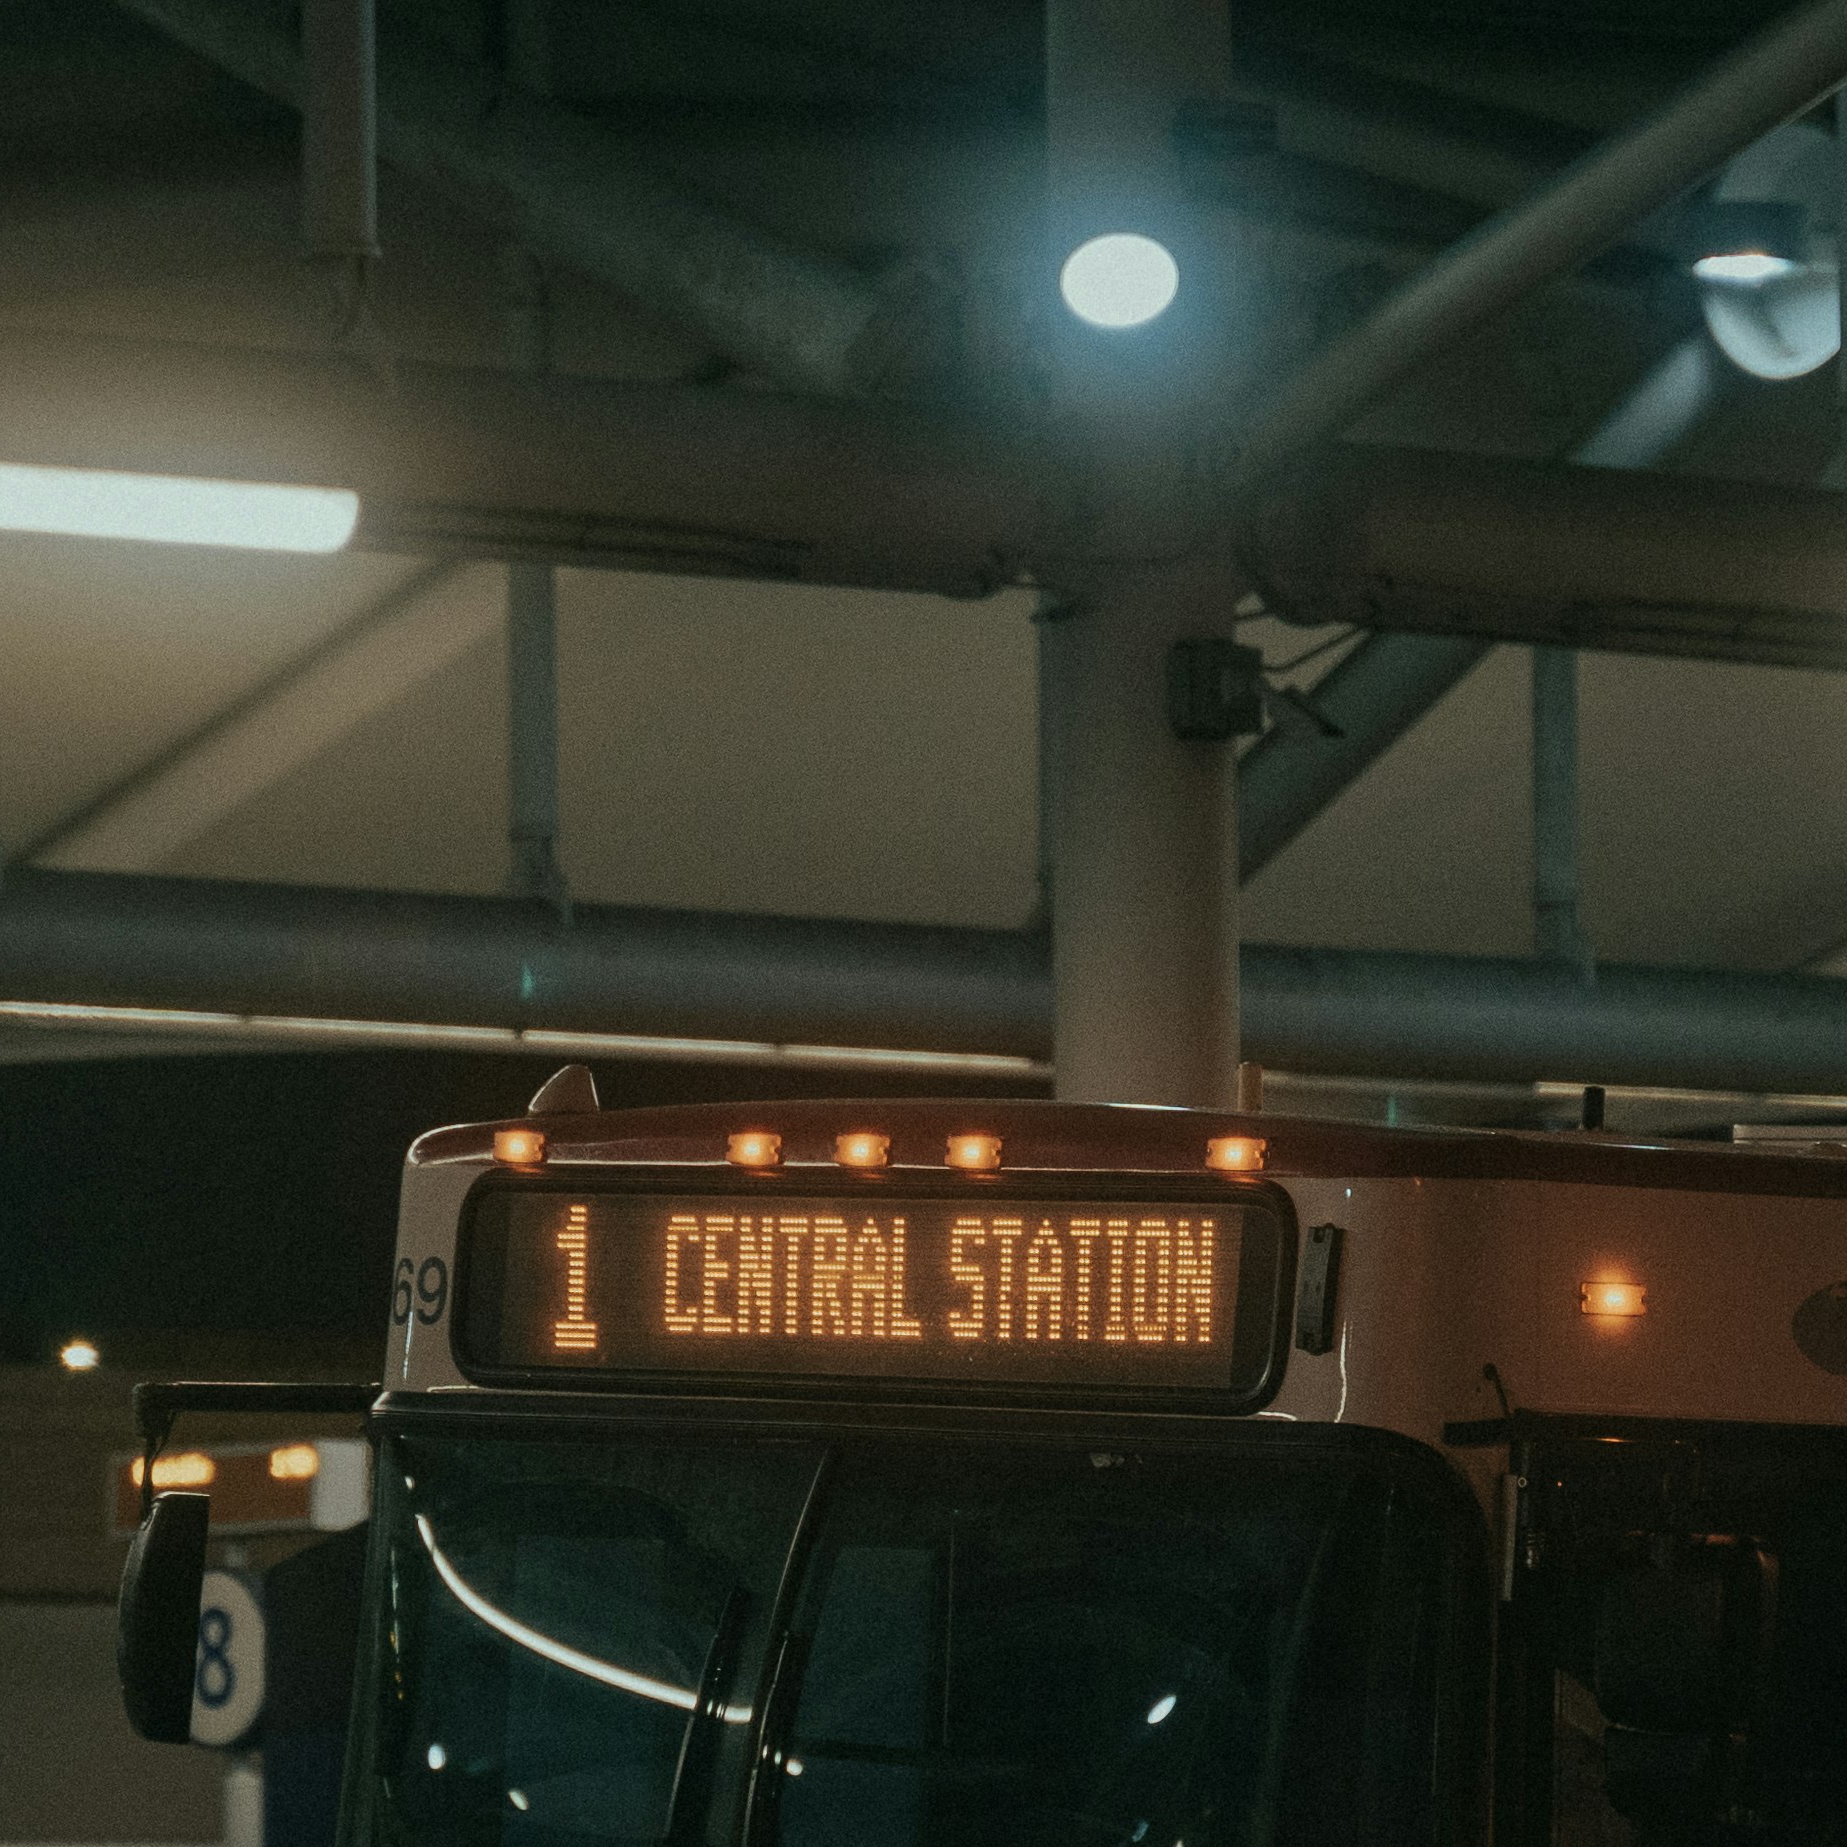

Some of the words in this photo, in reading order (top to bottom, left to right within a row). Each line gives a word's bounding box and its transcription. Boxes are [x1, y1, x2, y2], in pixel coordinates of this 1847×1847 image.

[393, 1256, 448, 1325] 69
[554, 1204, 598, 1348] 1
[665, 1215, 922, 1339] CENTRAL
[950, 1217, 1213, 1343] STATION
[196, 1608, 235, 1707] 8
